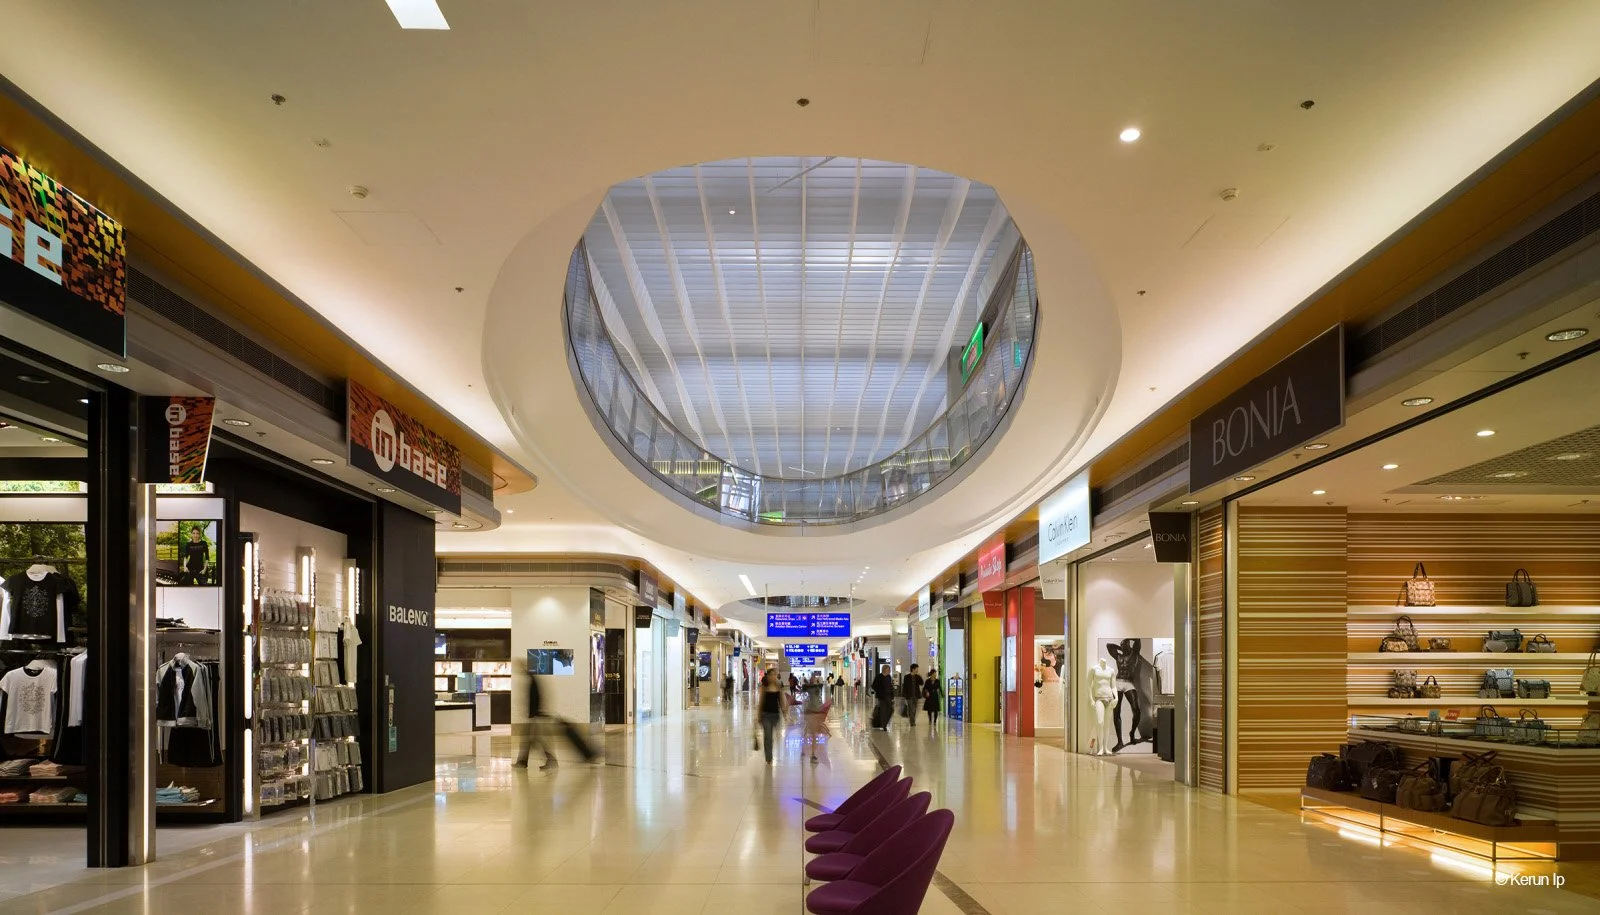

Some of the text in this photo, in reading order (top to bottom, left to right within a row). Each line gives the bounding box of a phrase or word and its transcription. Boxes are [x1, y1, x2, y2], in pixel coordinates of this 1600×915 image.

[1213, 375, 1302, 466] BONIA
[169, 427, 183, 476] base
[400, 431, 447, 490] base
[1155, 532, 1187, 542] BONIA
